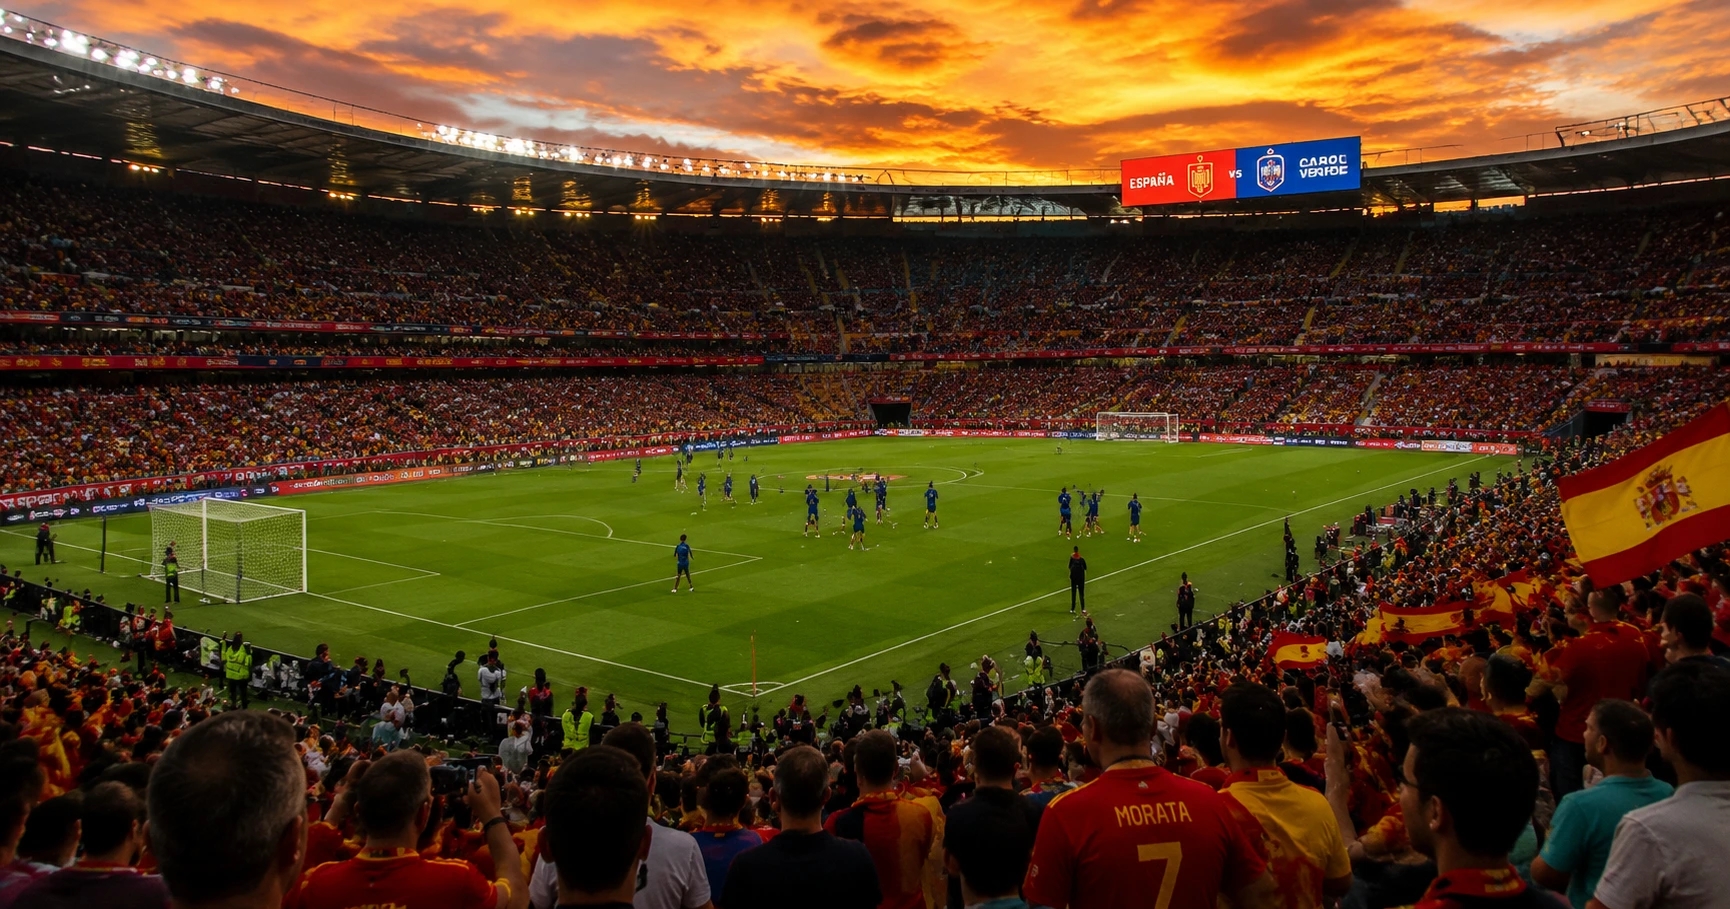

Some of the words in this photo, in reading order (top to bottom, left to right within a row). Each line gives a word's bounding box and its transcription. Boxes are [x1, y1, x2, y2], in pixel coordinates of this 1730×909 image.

[1130, 172, 1174, 189] ESPAÑA
[1114, 801, 1192, 828] MORATA
[1137, 841, 1183, 909] 7
